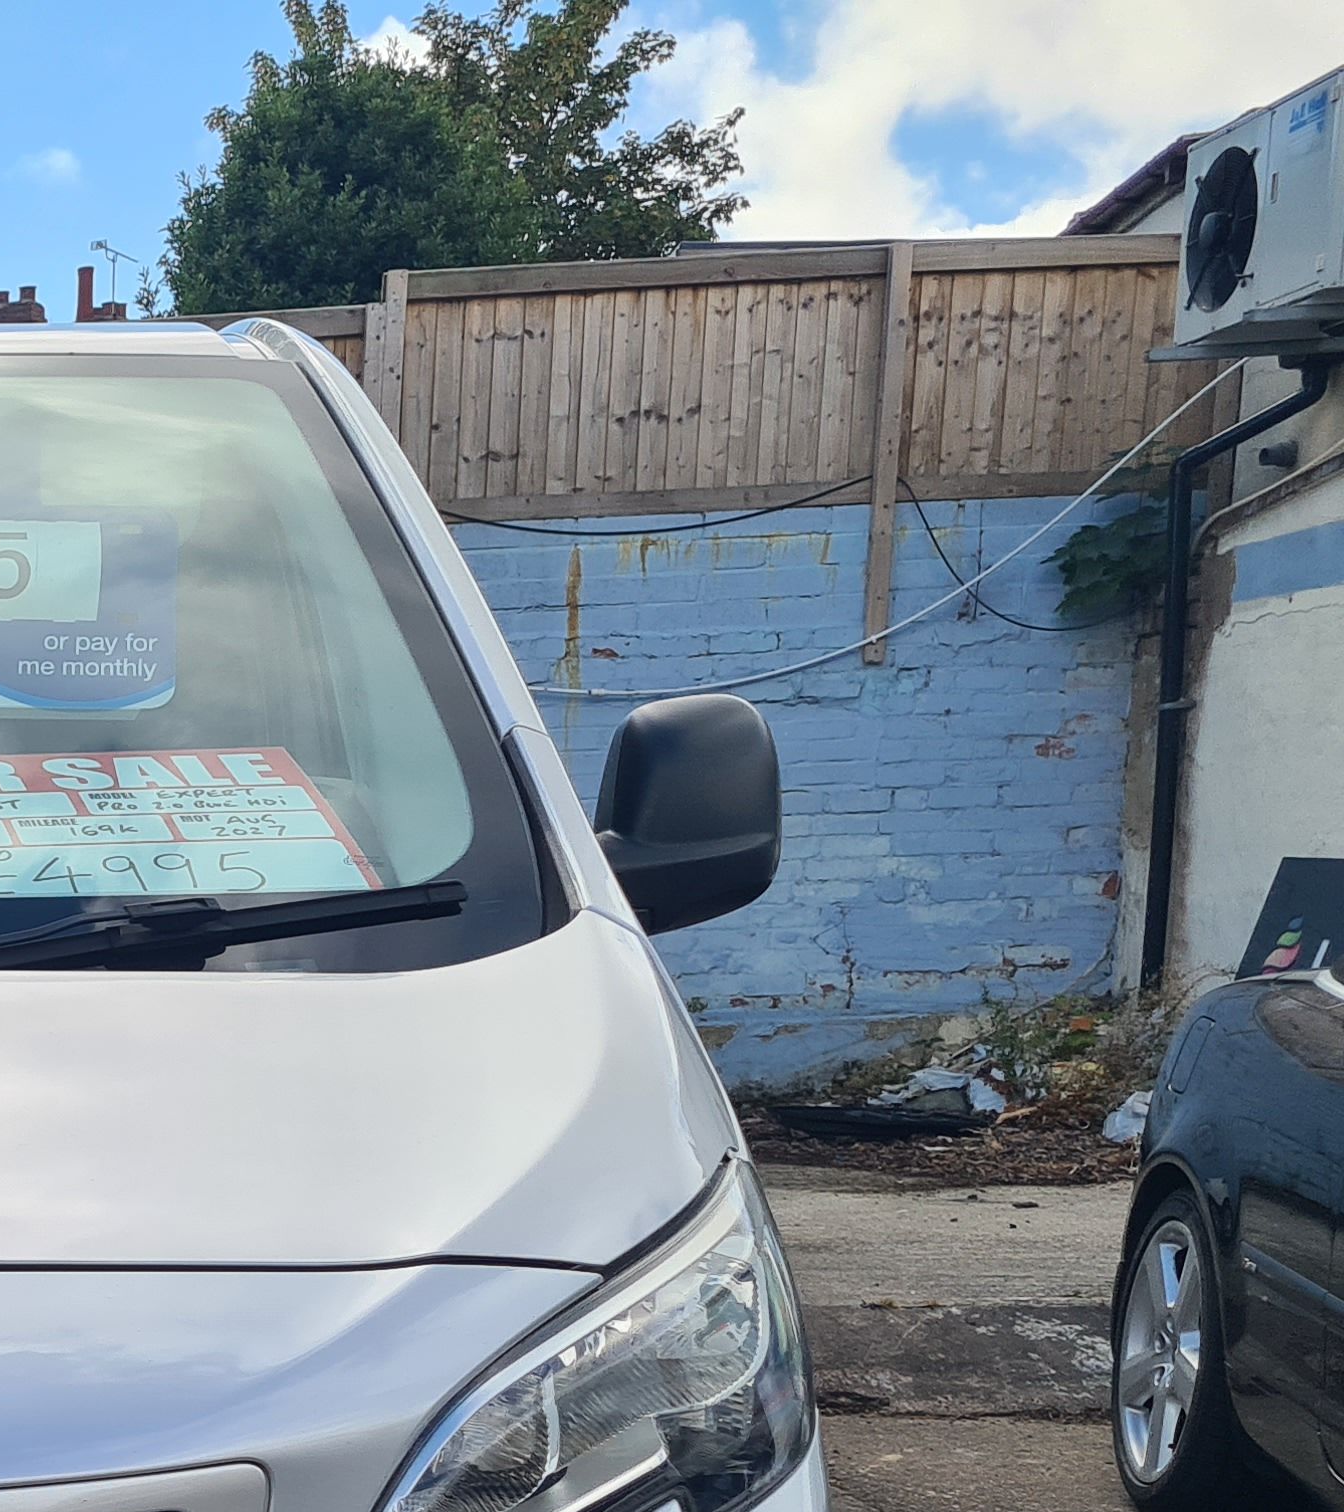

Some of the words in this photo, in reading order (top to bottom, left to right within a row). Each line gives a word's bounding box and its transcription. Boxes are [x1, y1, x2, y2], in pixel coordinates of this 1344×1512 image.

[43, 634, 69, 650] or
[75, 635, 118, 656] pay
[124, 632, 159, 652] for
[18, 659, 56, 676] me
[62, 657, 158, 682] monthly
[41, 753, 285, 791] SALE
[87, 791, 137, 801] MODEL
[155, 787, 256, 800] EXPERT
[97, 801, 138, 812] PRO
[152, 801, 184, 810] 2.0
[17, 817, 80, 828] MILEAGE
[179, 814, 212, 823] MOT
[226, 814, 278, 825] AUG
[210, 824, 287, 838] 2027
